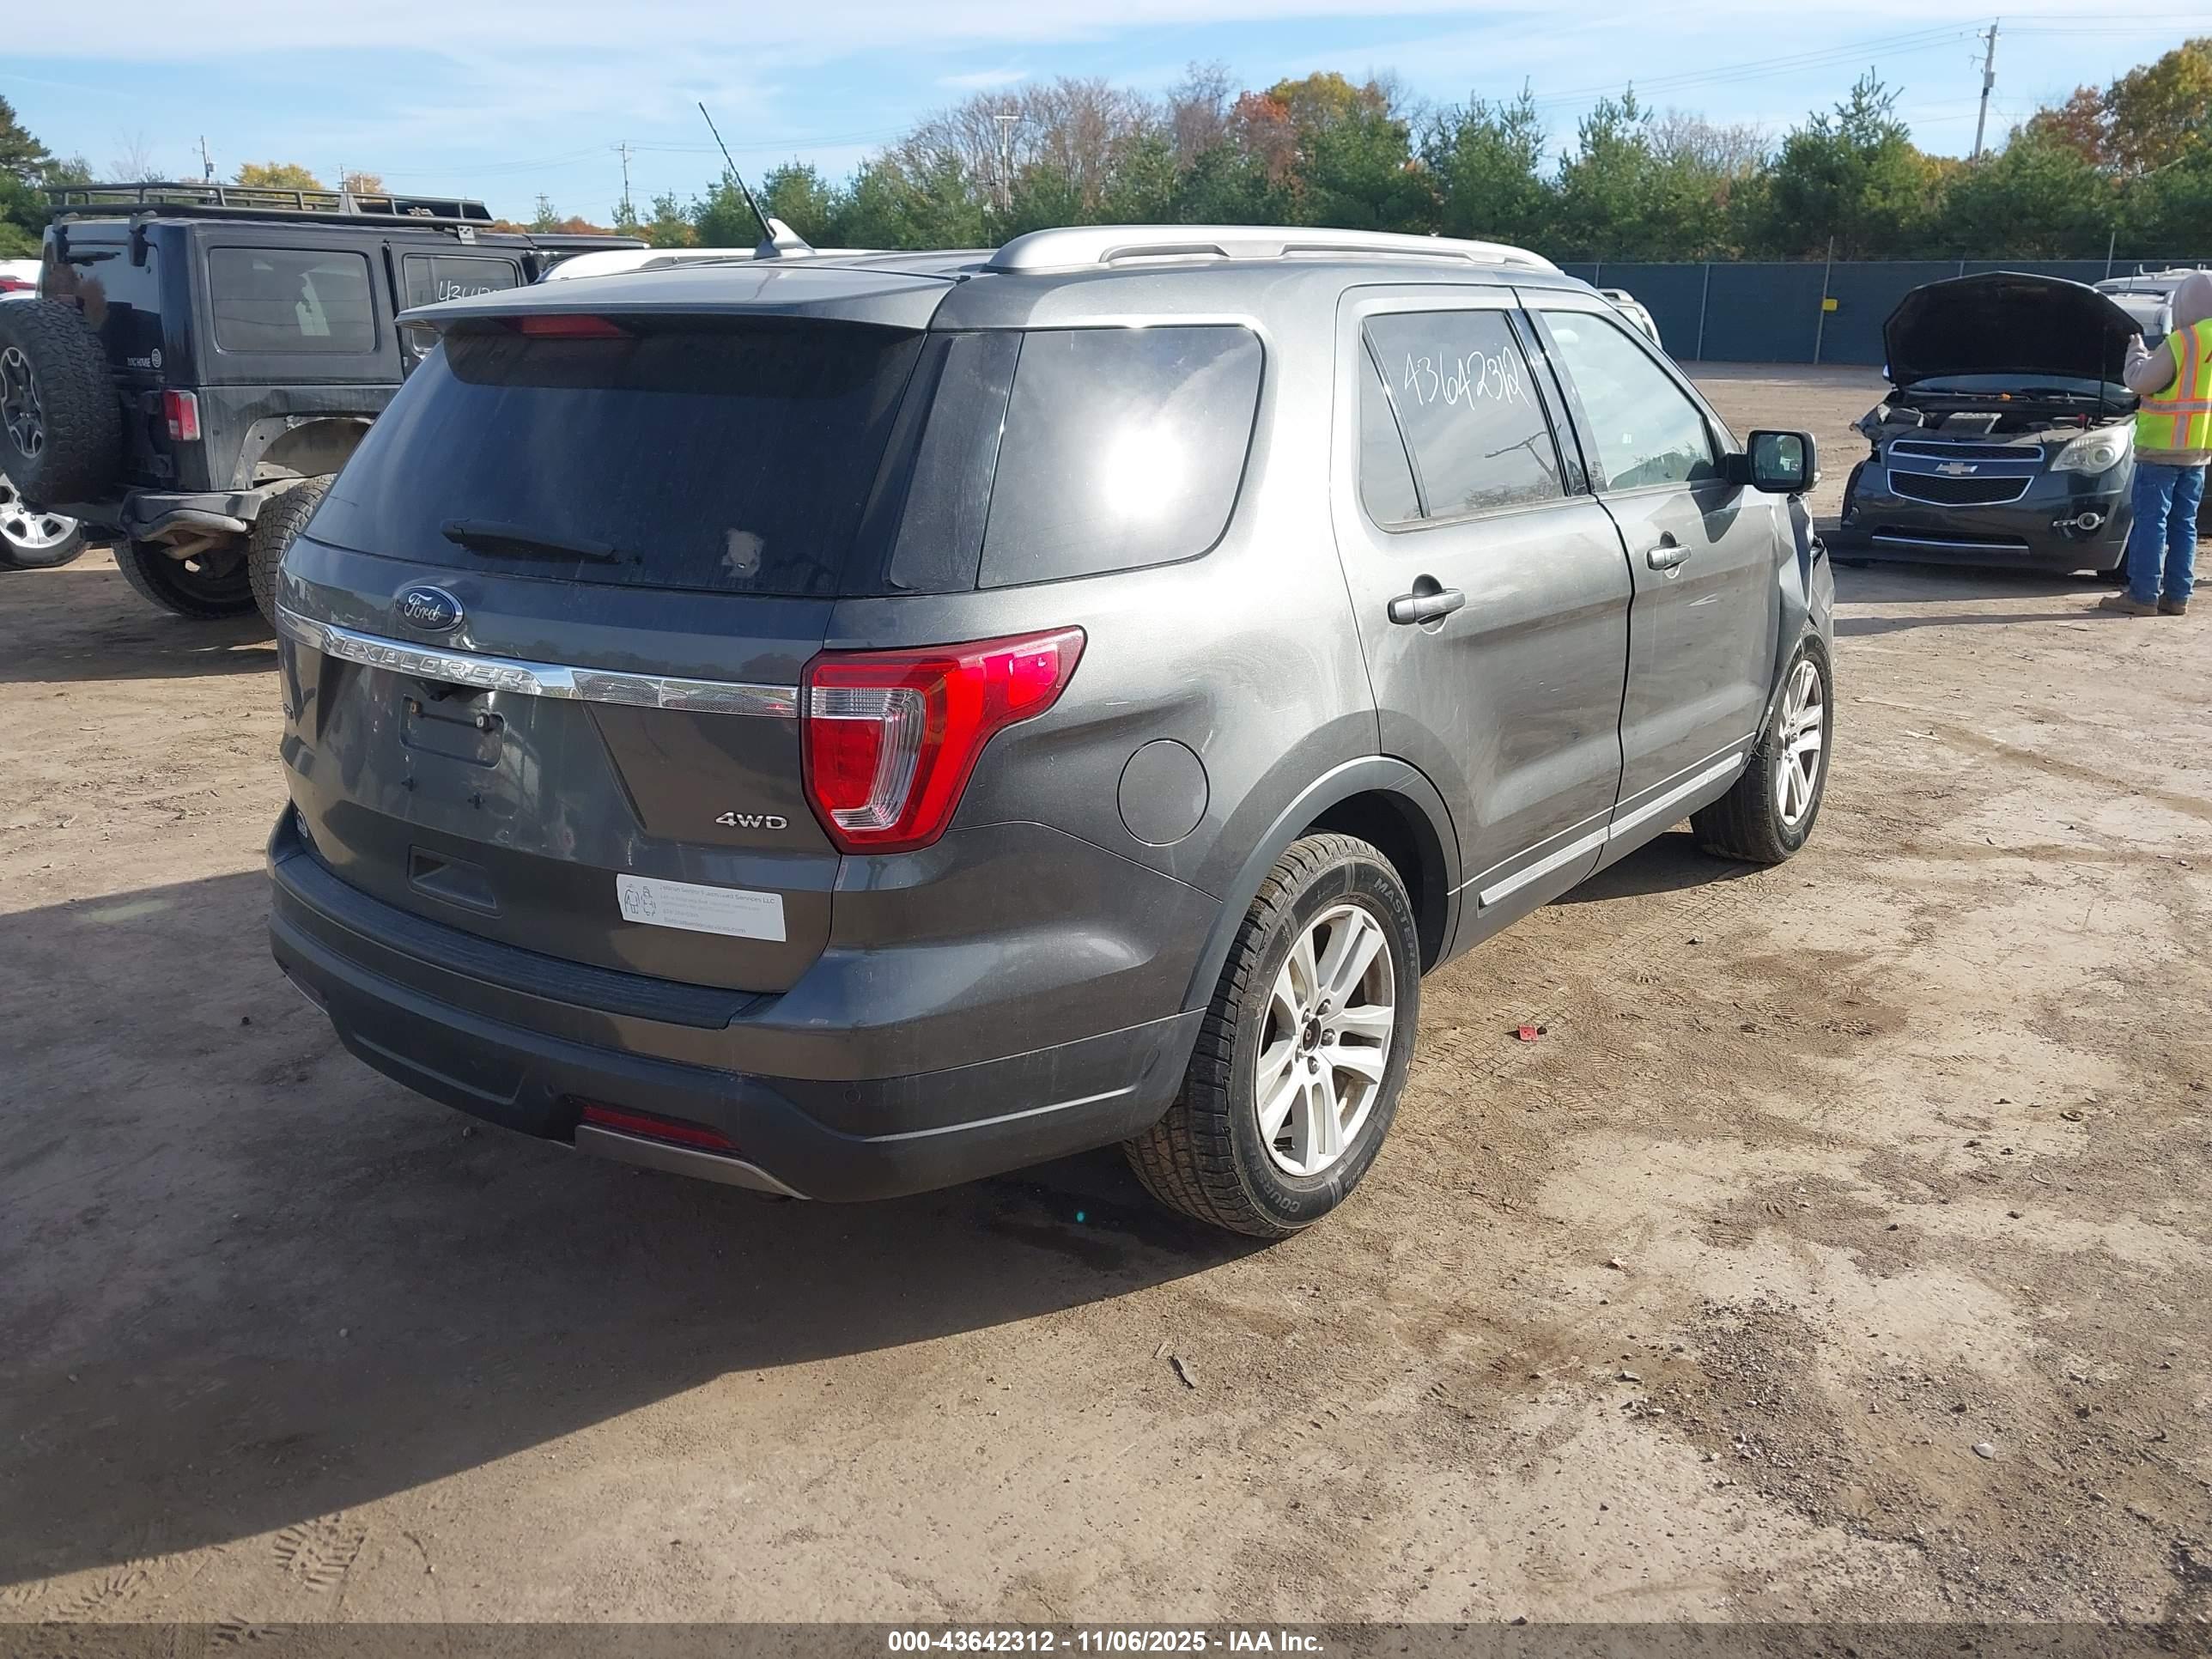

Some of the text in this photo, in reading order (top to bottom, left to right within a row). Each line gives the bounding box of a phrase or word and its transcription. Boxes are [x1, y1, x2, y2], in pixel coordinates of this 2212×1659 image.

[1404, 346, 1532, 410] 43642312
[404, 592, 441, 623] Ford
[341, 639, 526, 687] EXPLORER
[714, 811, 789, 831] 4WD
[1373, 877, 1419, 992] MASTERC
[1248, 1156, 1301, 1212] COURS
